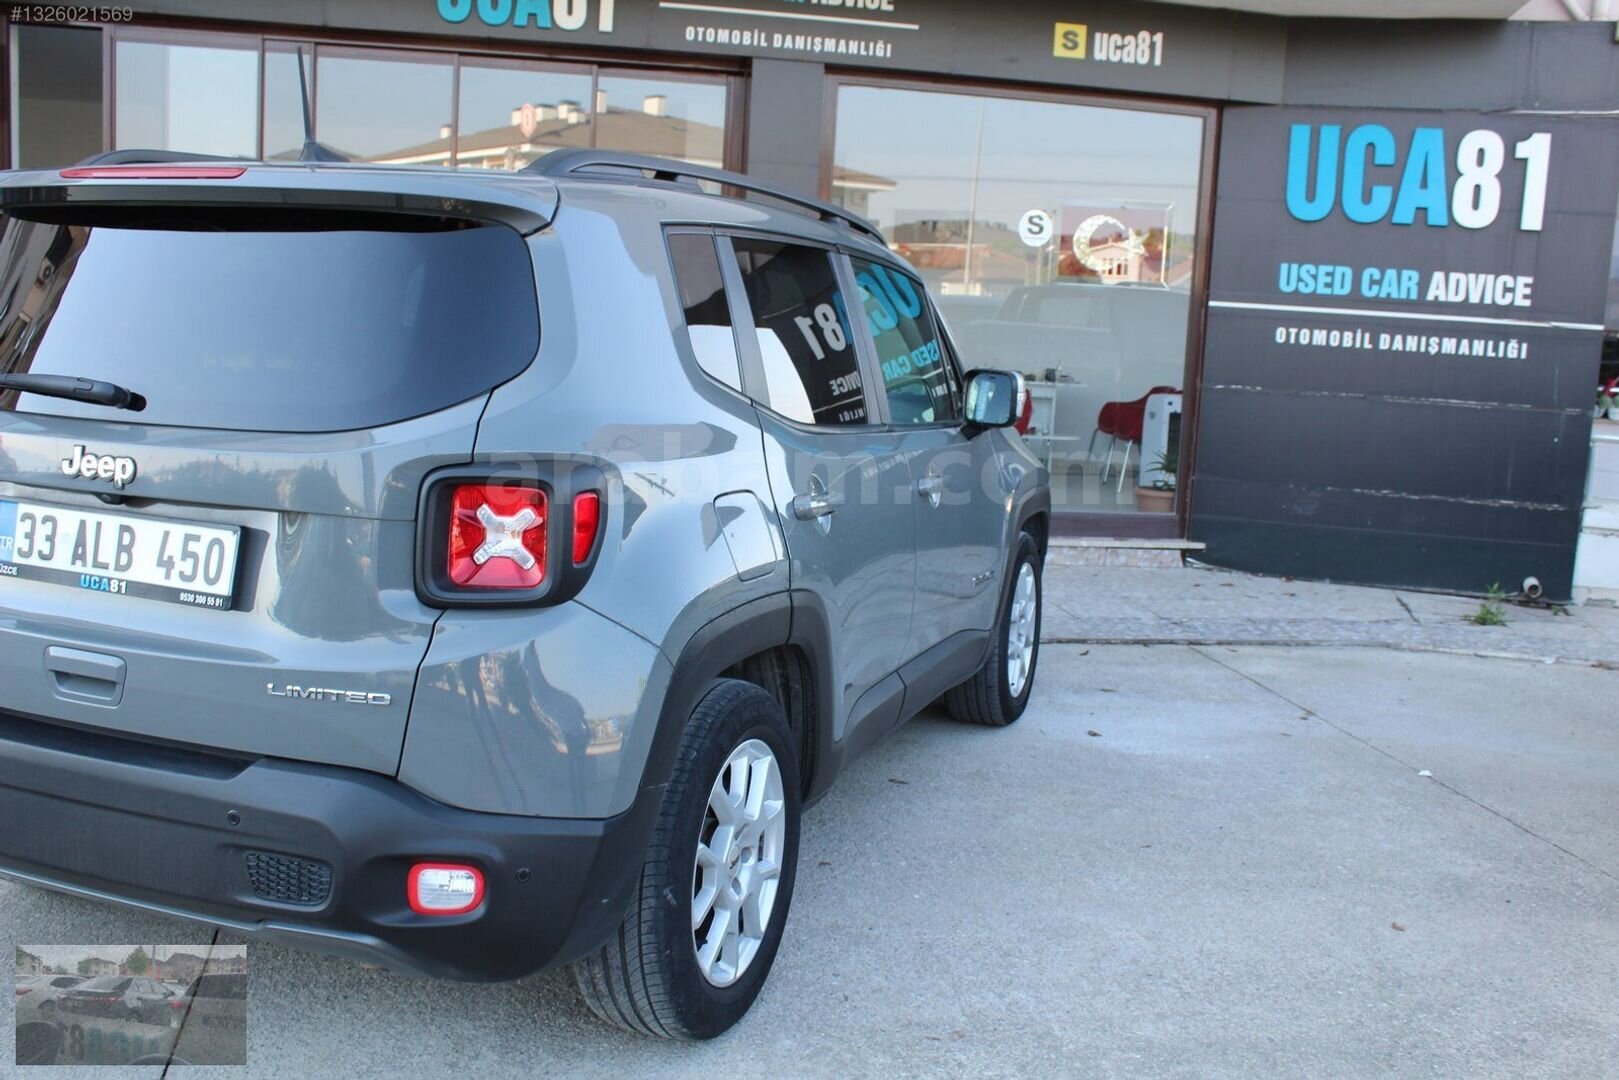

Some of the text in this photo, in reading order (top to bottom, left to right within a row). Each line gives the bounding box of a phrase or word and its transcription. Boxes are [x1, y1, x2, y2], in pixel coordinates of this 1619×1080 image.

[685, 26, 892, 58] OTOMOBİL DANIŞMANLIĞI
[1093, 30, 1163, 66] uca81
[1286, 124, 1552, 231] UCA81
[1279, 262, 1534, 307] USED CAR ADVICE
[1275, 327, 1528, 360] OTOMOBİL DANIŞMANLIĞI
[61, 444, 137, 490] Jeep
[0, 535, 13, 551] TR
[17, 512, 225, 586] 33 ALB 450
[80, 574, 127, 594] UCA81
[267, 683, 391, 705] LIMITED
